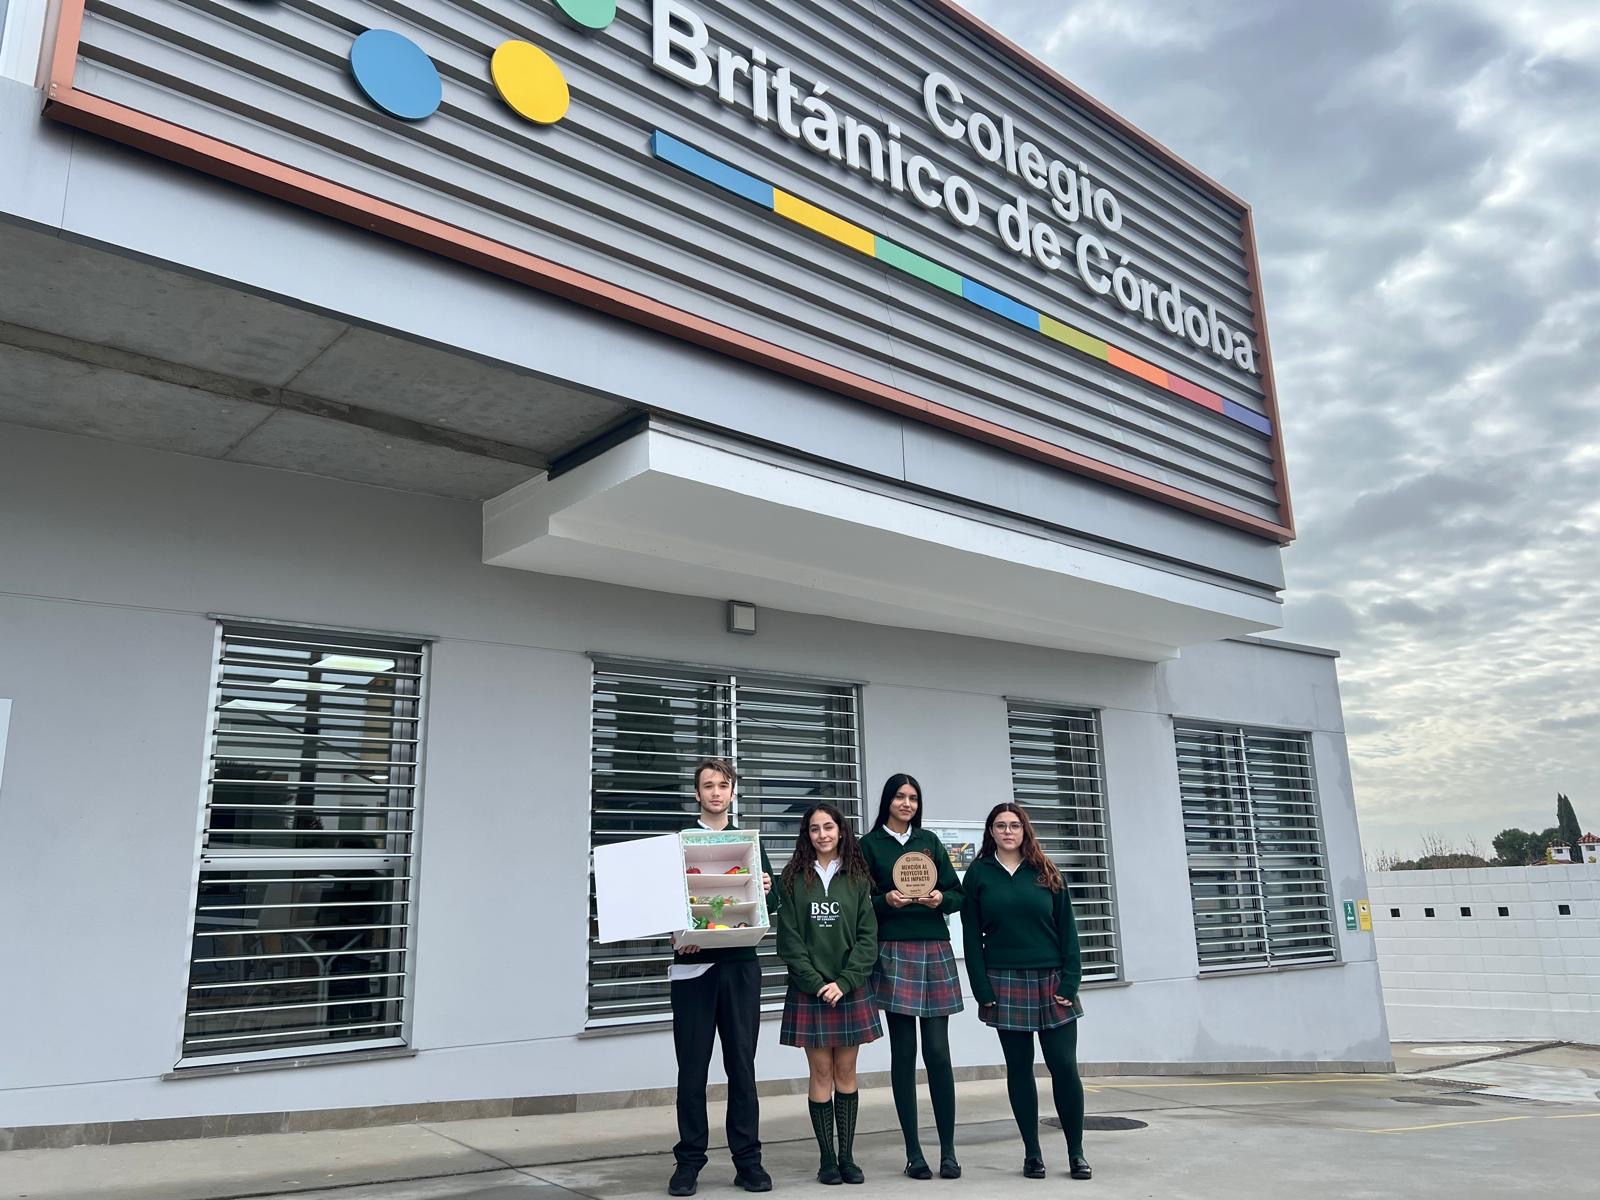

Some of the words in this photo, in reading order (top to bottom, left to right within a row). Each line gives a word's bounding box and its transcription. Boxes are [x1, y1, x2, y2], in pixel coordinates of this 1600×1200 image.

[652, 0, 980, 226] Británico
[997, 194, 1062, 270] de
[1076, 233, 1257, 374] Córdoba
[923, 71, 1123, 232] Colegio
[811, 901, 840, 915] BSC
